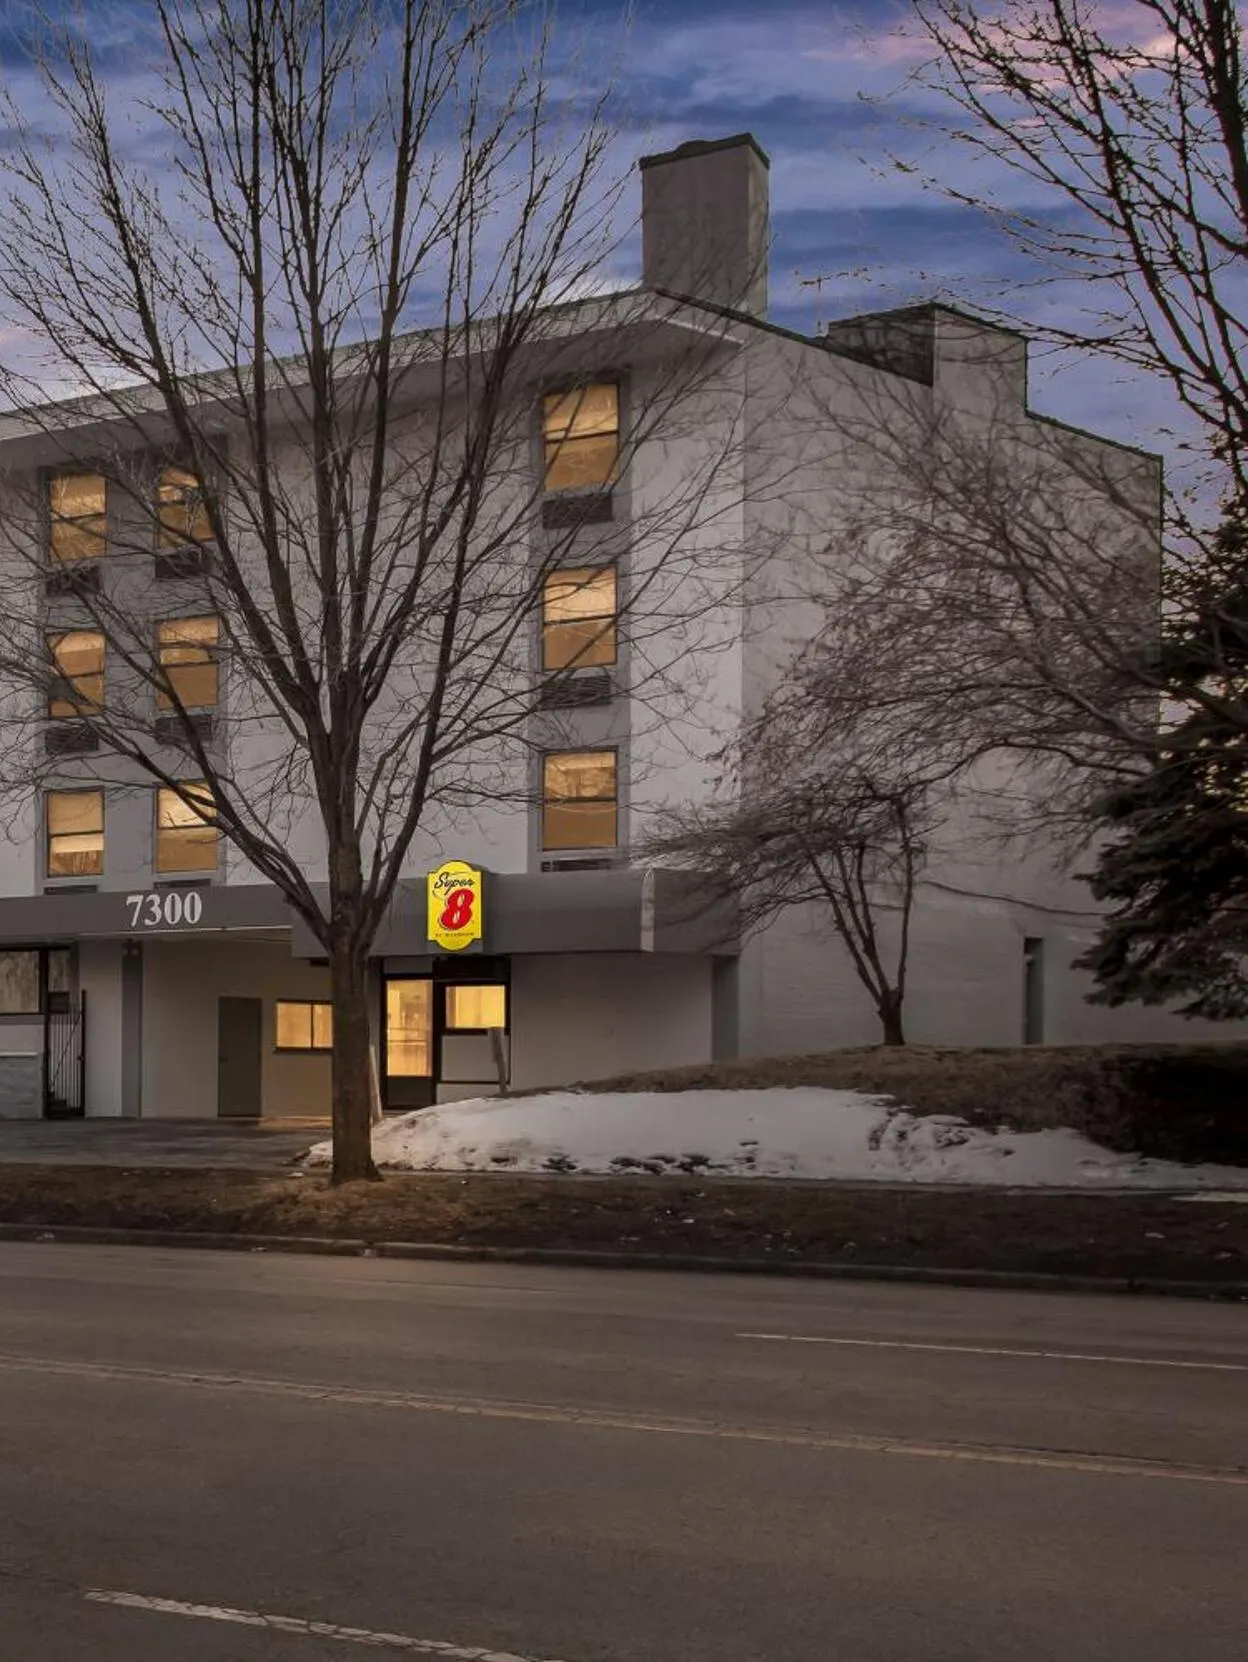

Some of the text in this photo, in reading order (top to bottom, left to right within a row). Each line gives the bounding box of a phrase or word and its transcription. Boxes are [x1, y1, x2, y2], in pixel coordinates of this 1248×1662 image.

[434, 872, 474, 895] Super
[126, 891, 202, 927] 7300
[439, 888, 475, 930] 8
